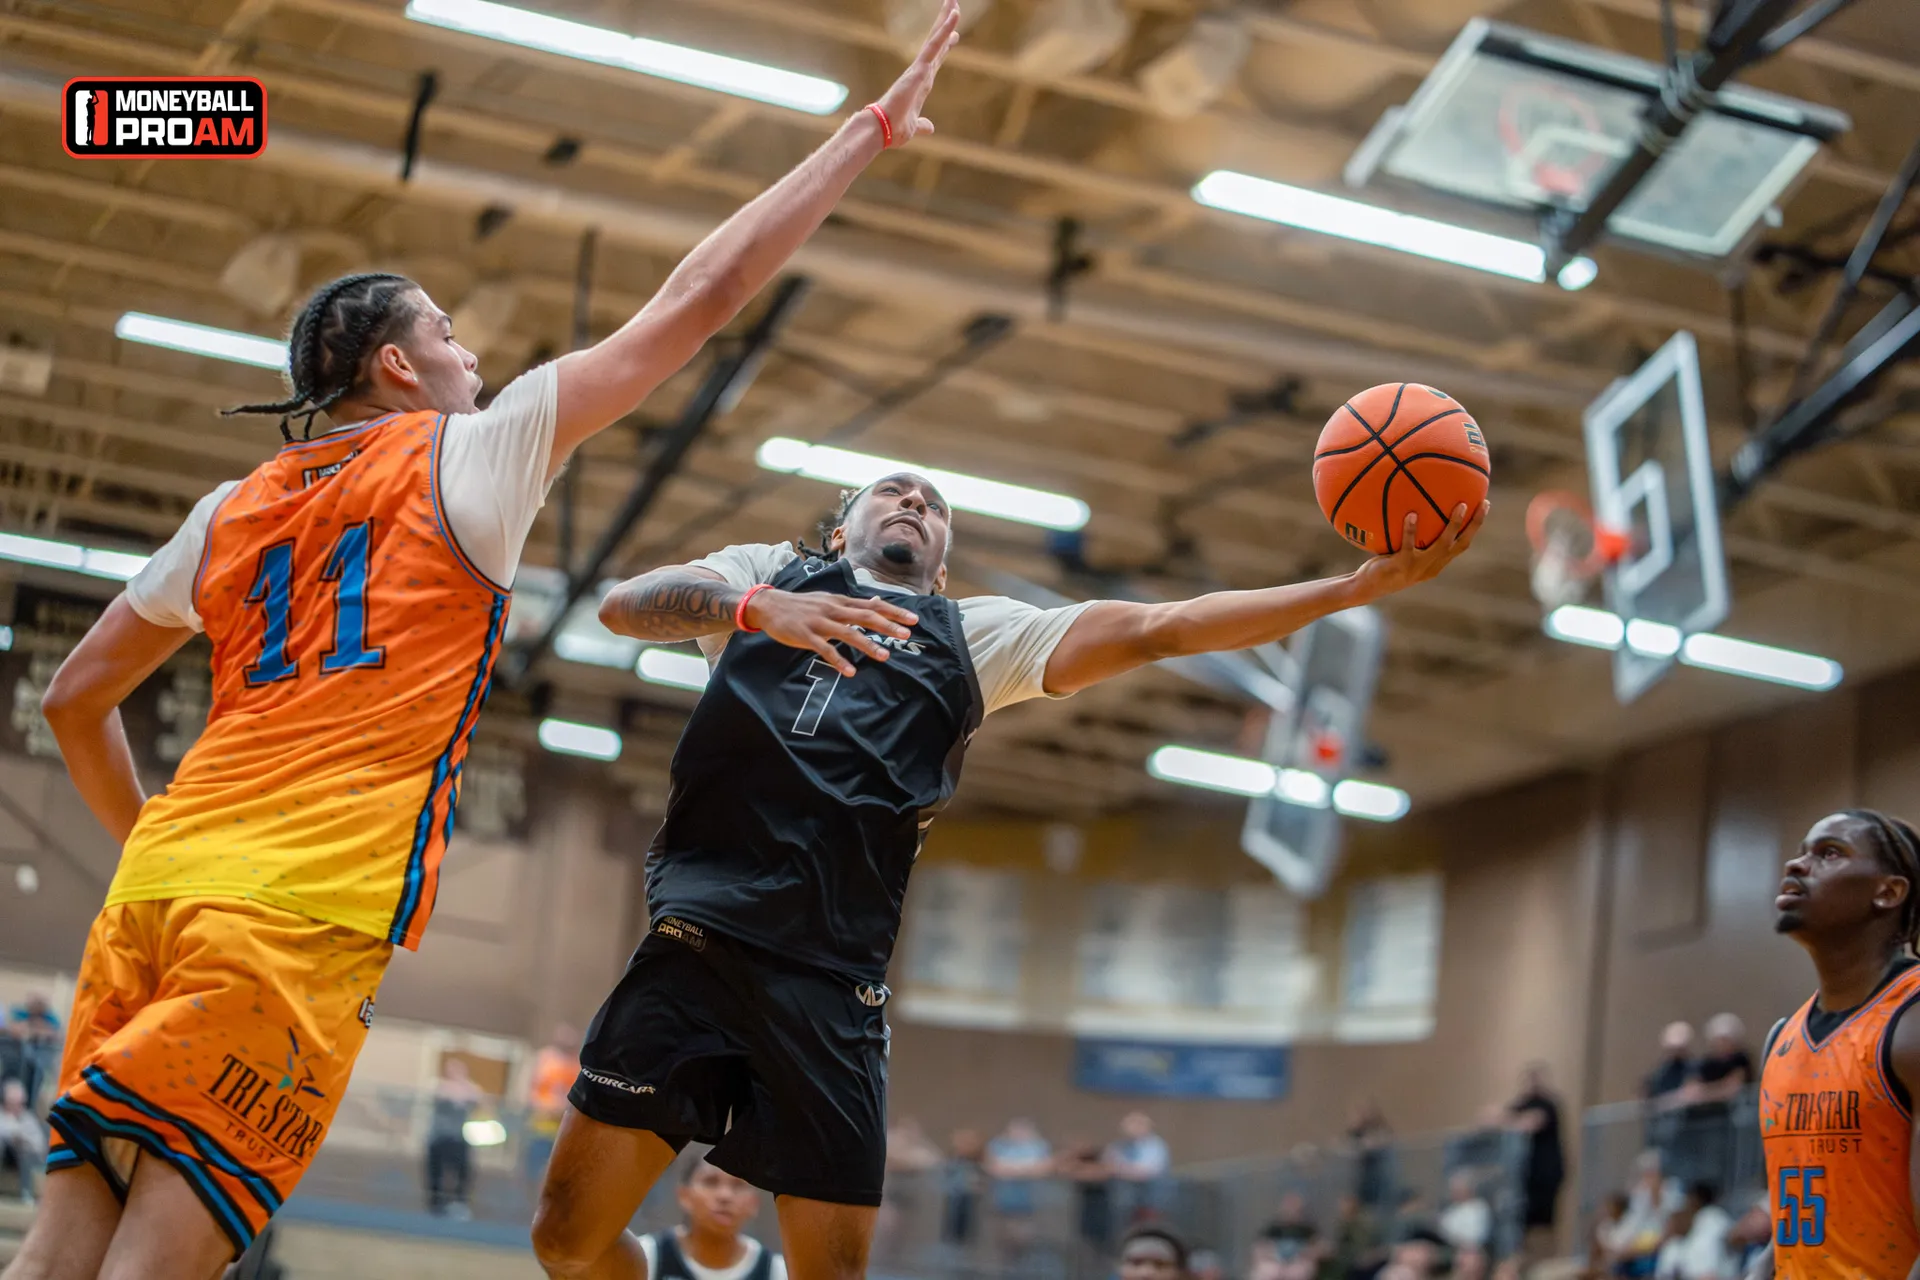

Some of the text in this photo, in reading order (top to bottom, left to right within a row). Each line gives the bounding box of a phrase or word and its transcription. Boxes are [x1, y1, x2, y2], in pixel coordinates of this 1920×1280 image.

[243, 516, 387, 688] 11
[207, 1053, 324, 1157] TRI-STAR
[223, 1121, 279, 1163] TRUST
[1809, 1138, 1863, 1155] TRUST
[1776, 1166, 1827, 1247] 55
